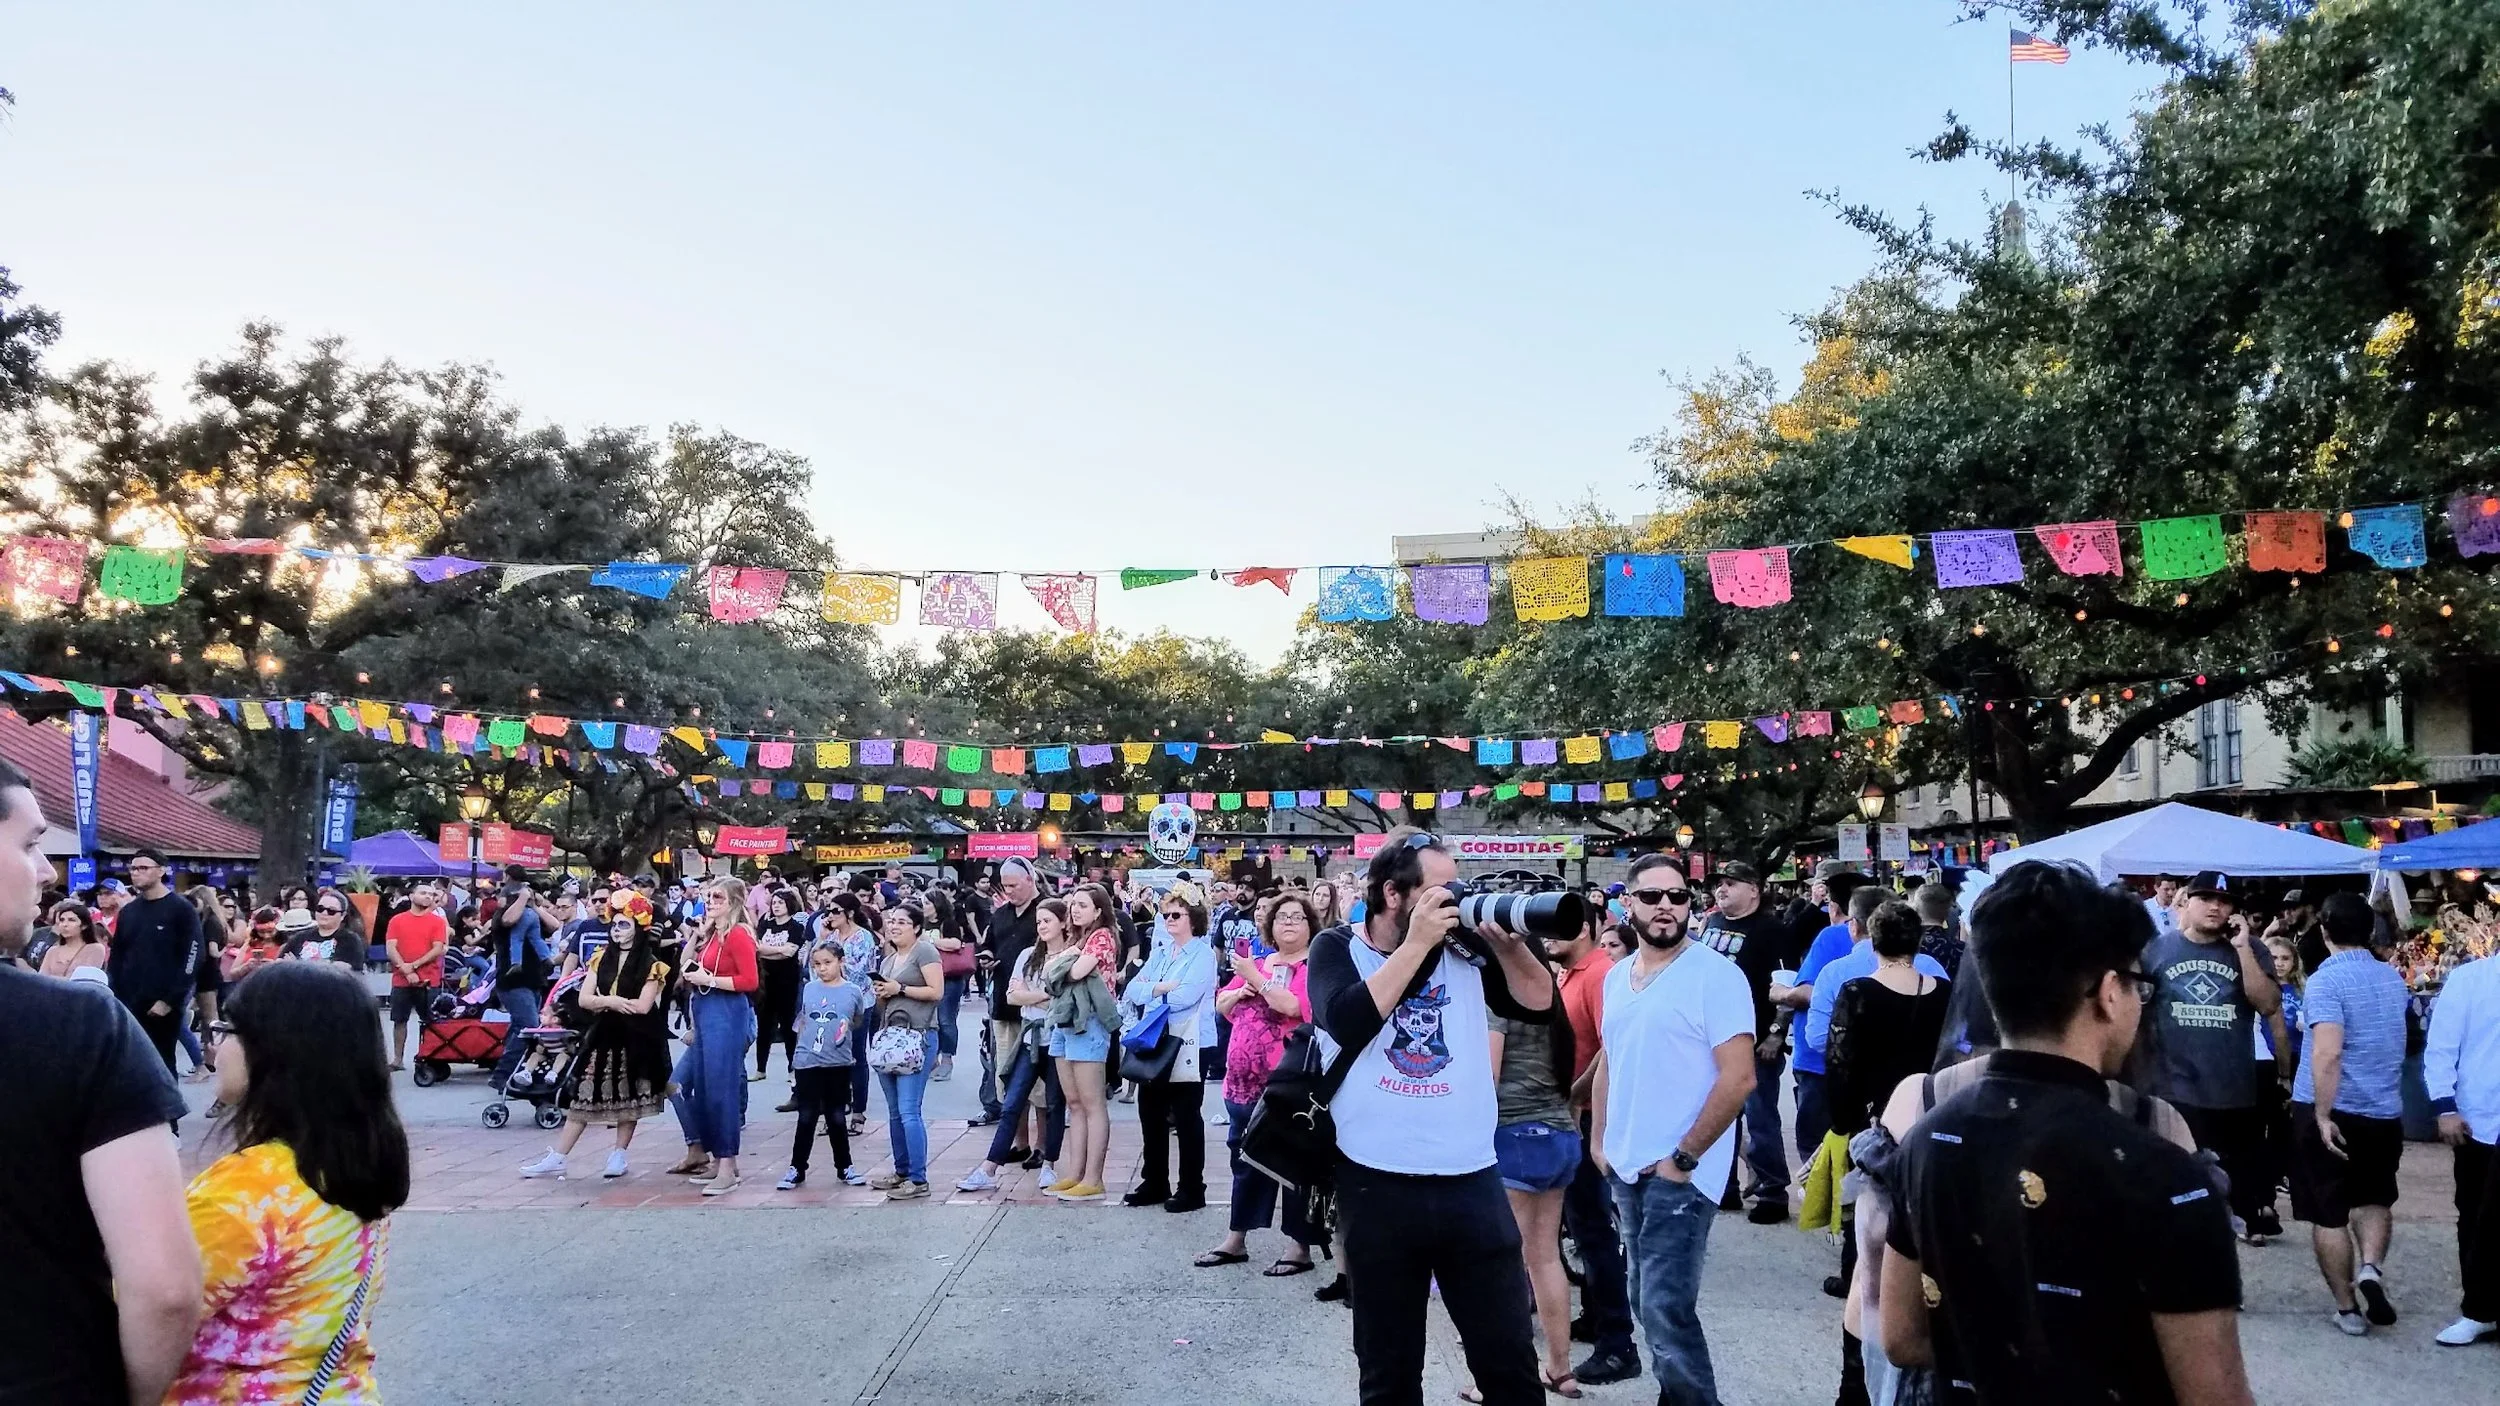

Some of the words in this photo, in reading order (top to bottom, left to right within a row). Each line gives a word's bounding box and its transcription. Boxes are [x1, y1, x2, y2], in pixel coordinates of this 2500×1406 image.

[729, 838, 748, 848] FACE
[748, 839, 778, 849] PAINTING
[1460, 842, 1565, 853] GORDITAS
[817, 848, 862, 858] FAJITA
[866, 846, 909, 856] TACOS
[2165, 960, 2239, 982] HOUSTON
[2180, 1006, 2229, 1019] ASTROS
[2178, 1019, 2232, 1030] BASEBALL
[1379, 1075, 1450, 1095] MUERTOS
